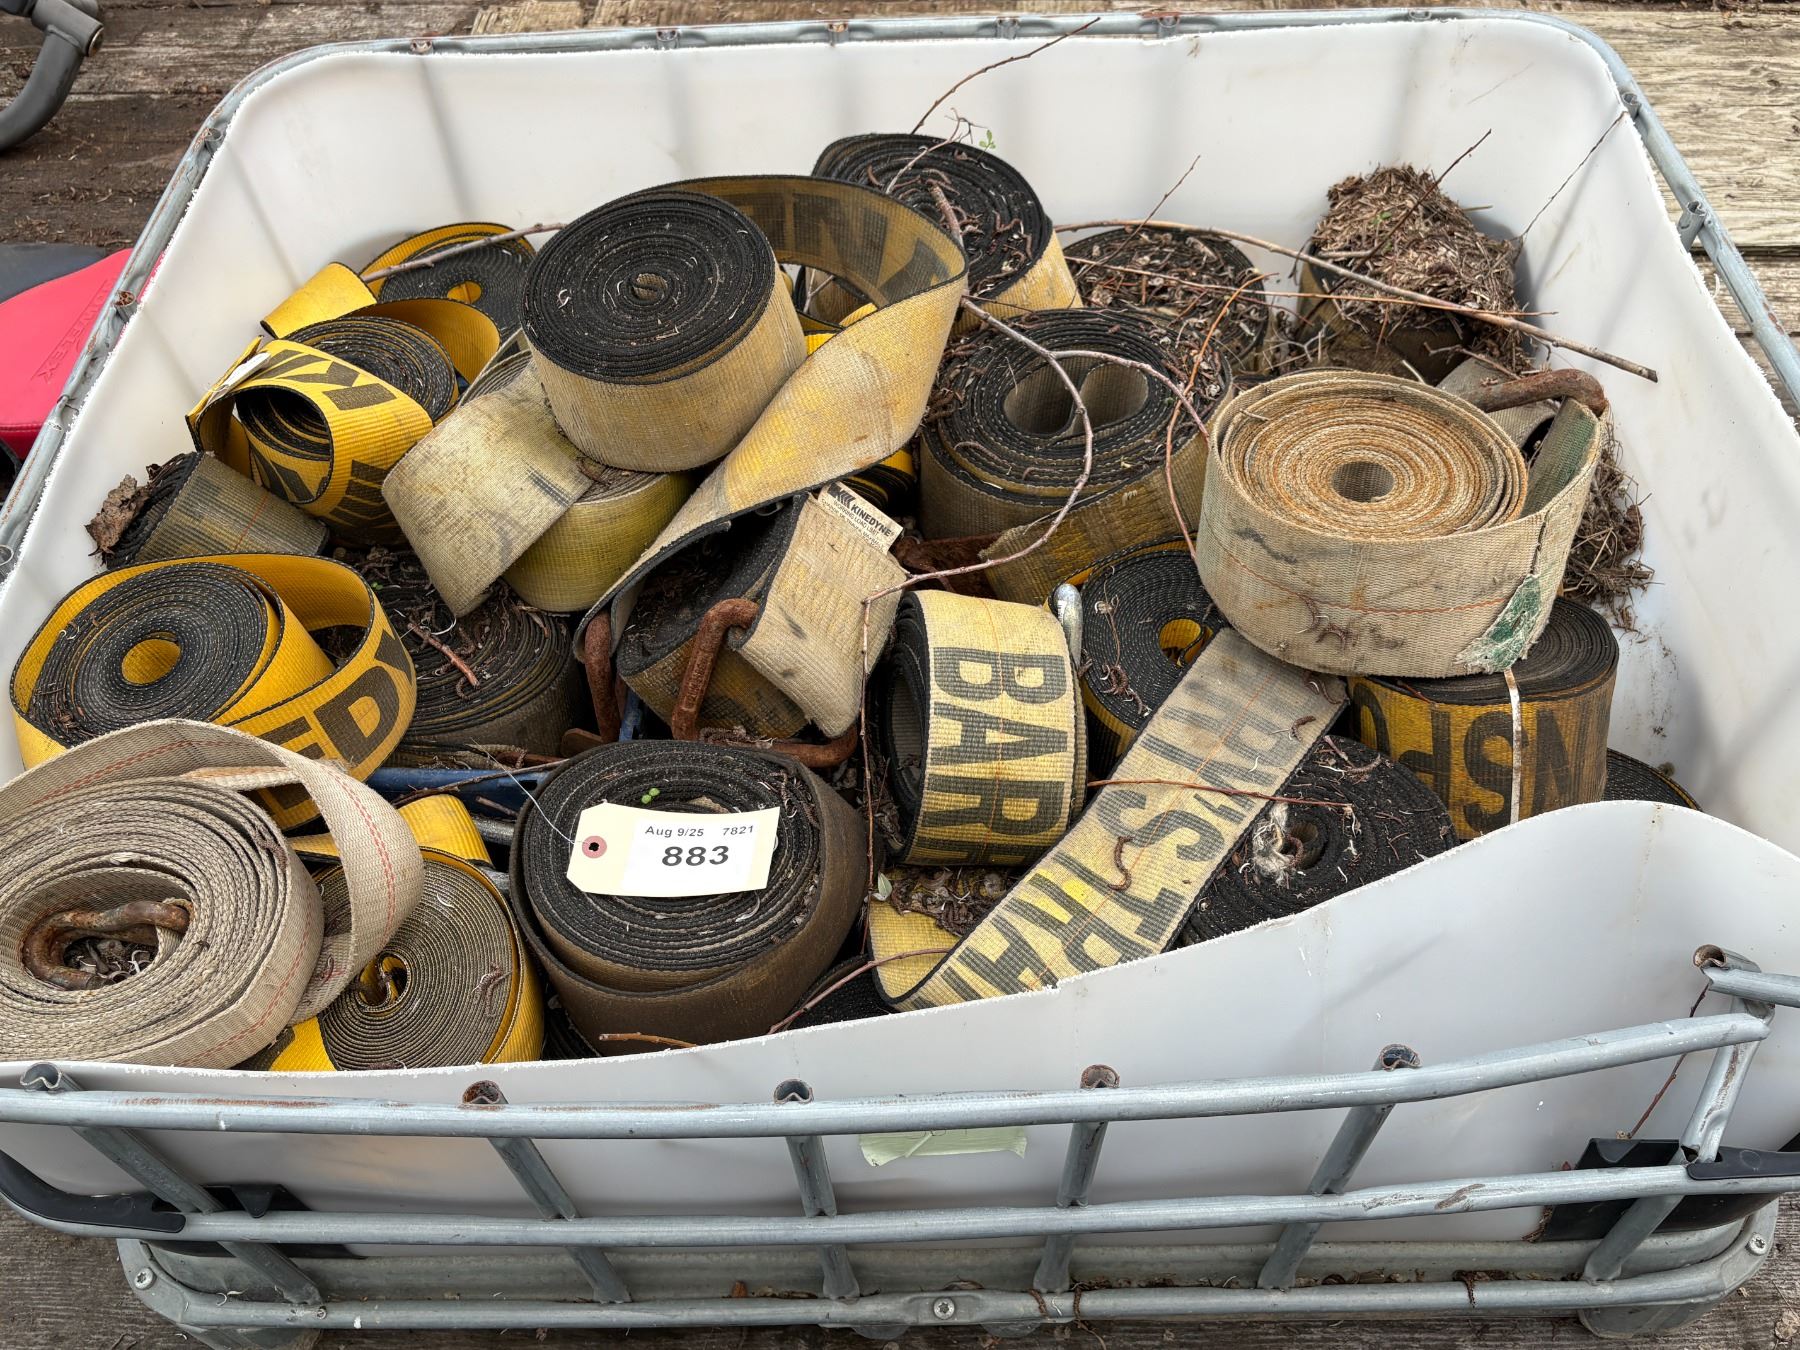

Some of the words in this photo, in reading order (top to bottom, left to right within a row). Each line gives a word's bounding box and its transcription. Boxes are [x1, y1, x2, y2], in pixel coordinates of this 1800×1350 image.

[644, 825, 673, 838] Aug
[677, 827, 705, 837] 9/25
[722, 825, 754, 836] 7821
[661, 845, 730, 867] 883
